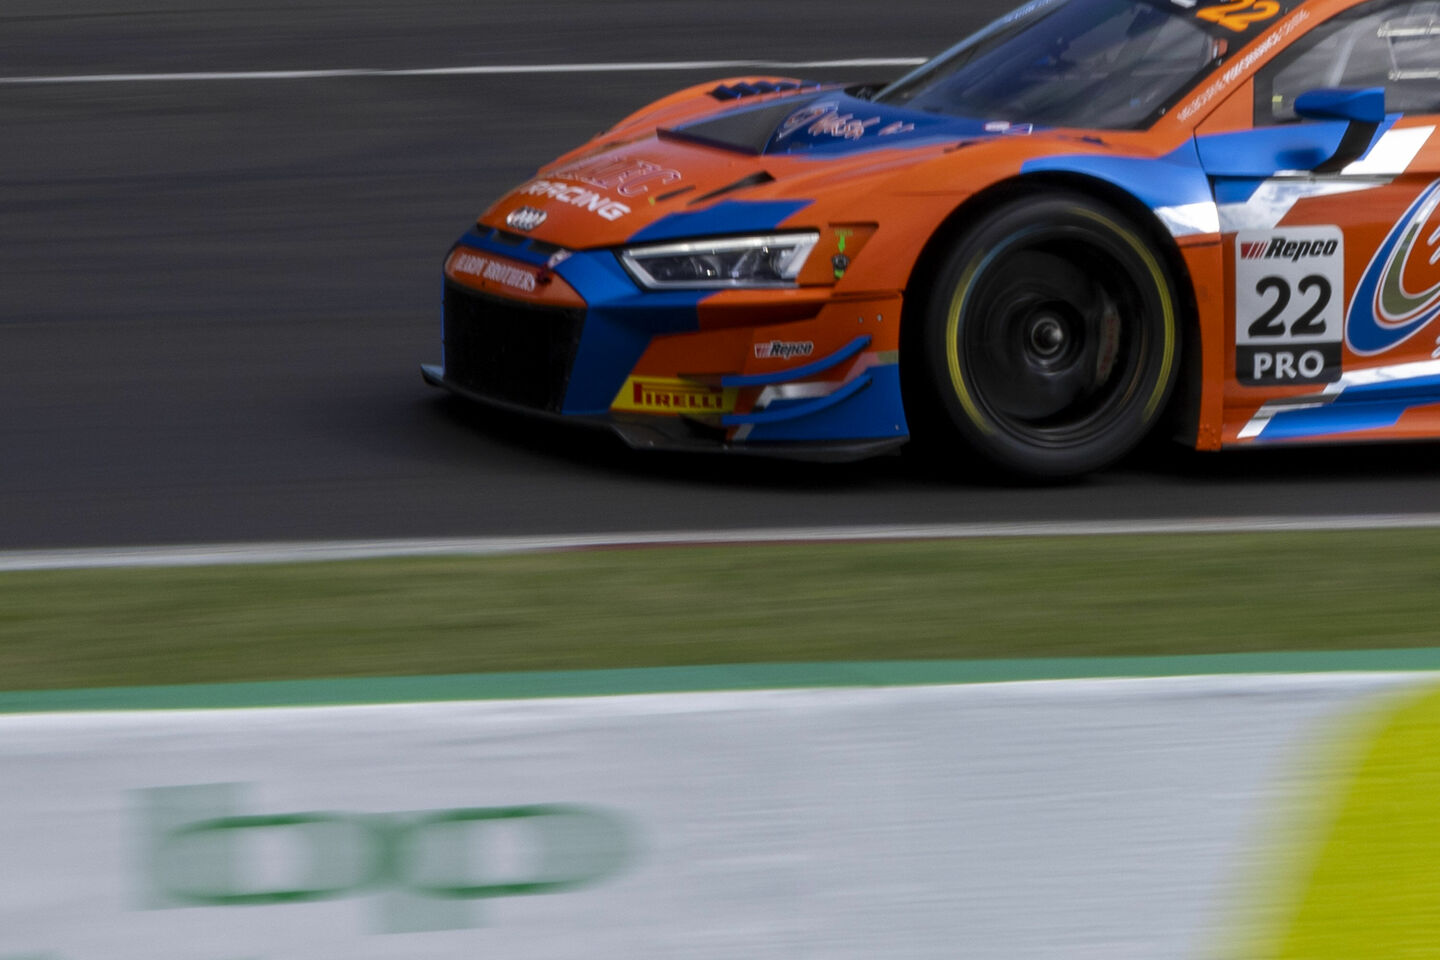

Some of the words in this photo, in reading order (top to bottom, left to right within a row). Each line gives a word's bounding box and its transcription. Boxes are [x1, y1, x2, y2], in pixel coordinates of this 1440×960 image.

[519, 180, 631, 222] RACING
[1265, 237, 1338, 262] Repco
[1248, 274, 1332, 338] 22
[769, 340, 814, 360] Repco
[1253, 349, 1325, 380] PRO
[632, 381, 724, 409] PIRELLI
[125, 781, 645, 935] bp
